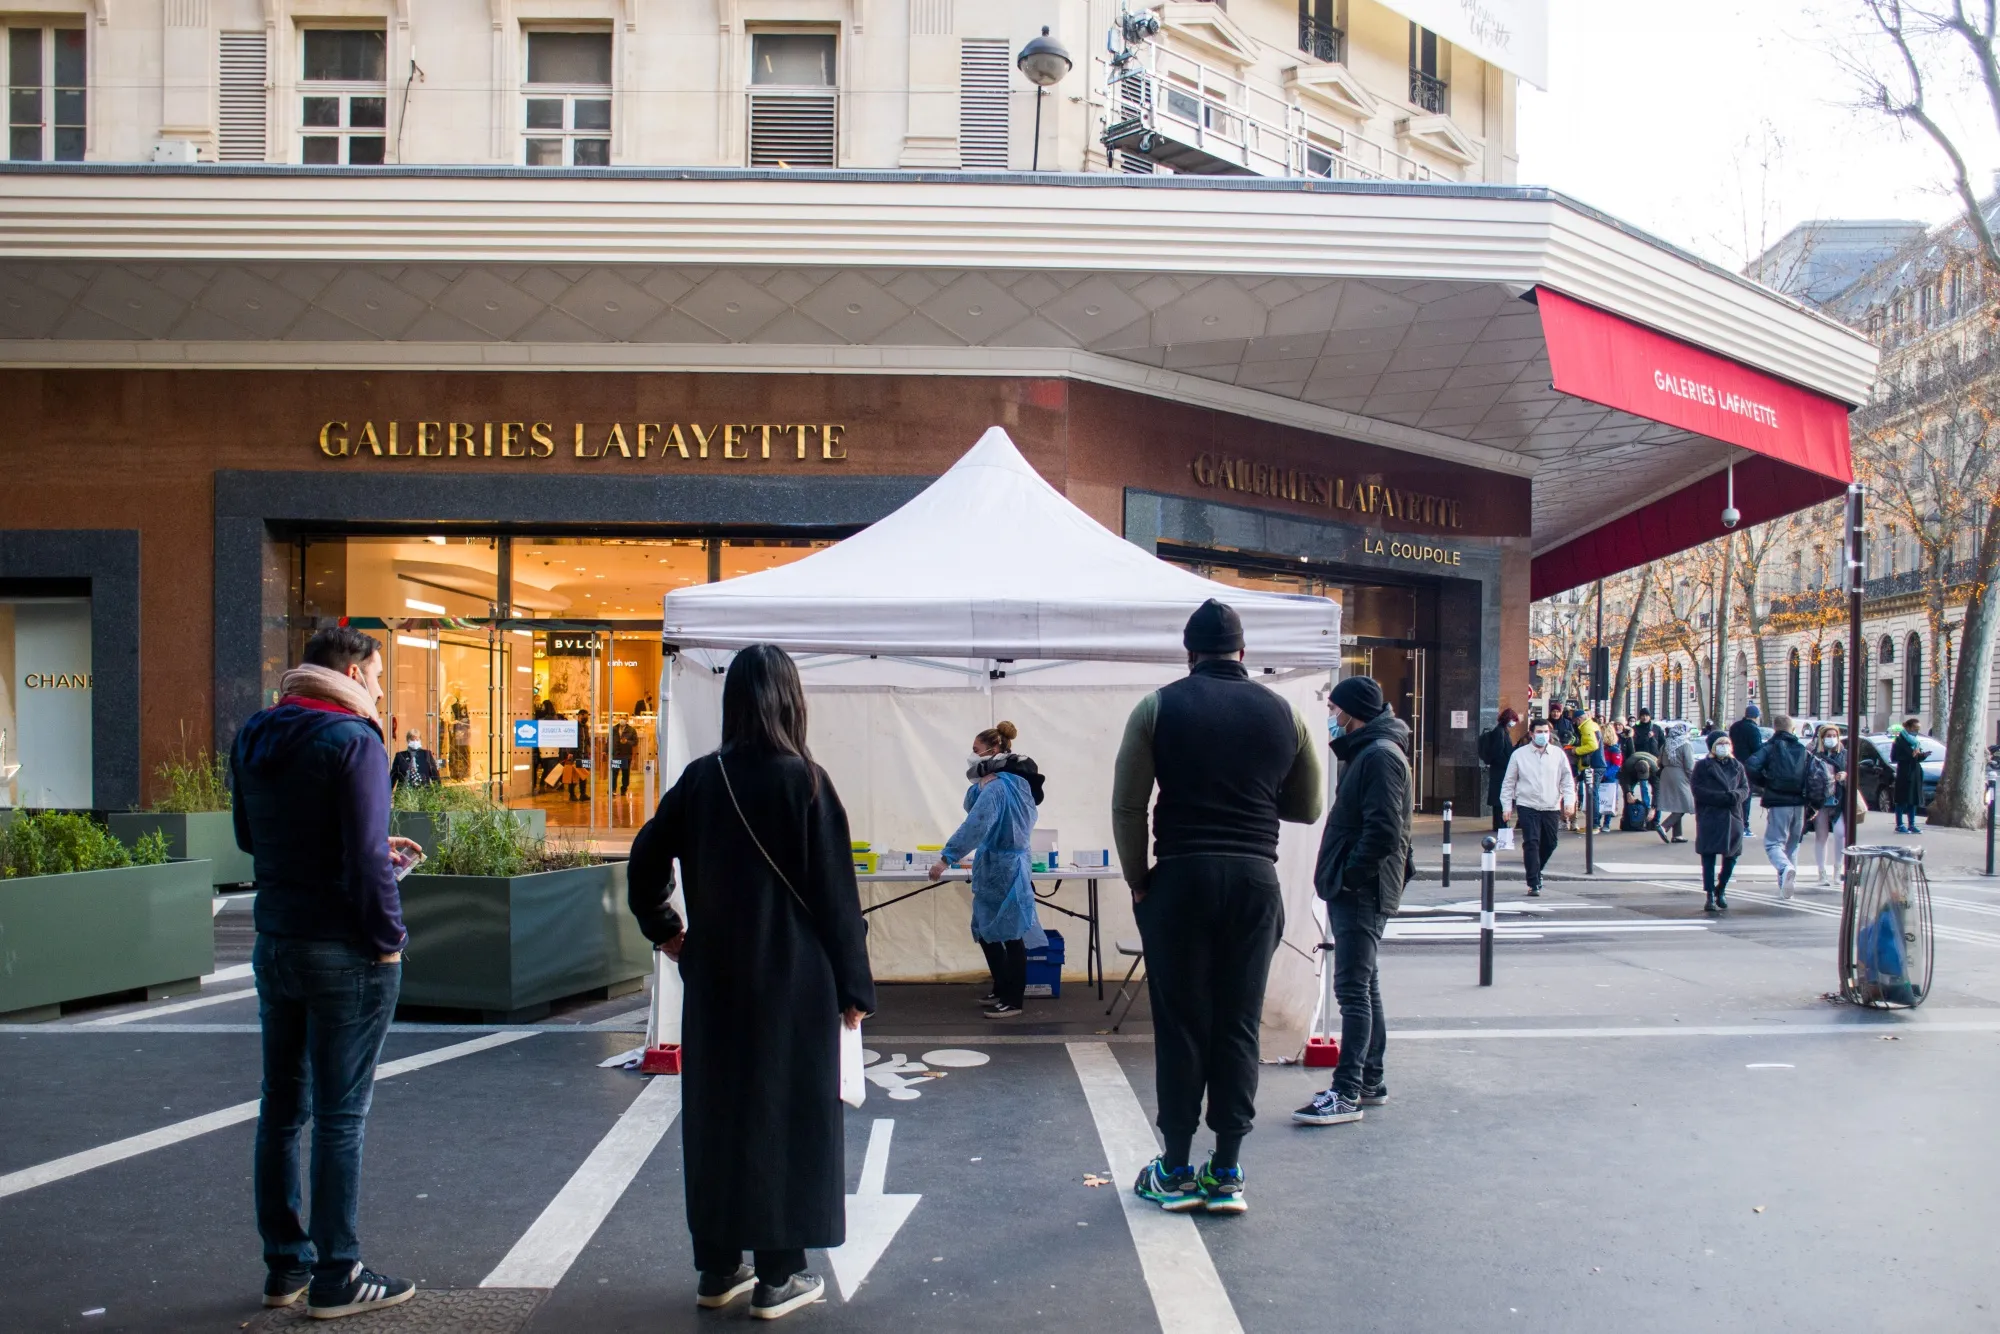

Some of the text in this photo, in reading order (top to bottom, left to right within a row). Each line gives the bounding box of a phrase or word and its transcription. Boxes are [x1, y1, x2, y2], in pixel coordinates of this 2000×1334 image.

[1654, 370, 1778, 428] GALERIES LAFAYETTE
[319, 420, 847, 459] GALERIES LAFAYETTE
[1193, 452, 1462, 529] GALERIES LAFAYETTE
[1364, 538, 1461, 566] LA COUPOLE
